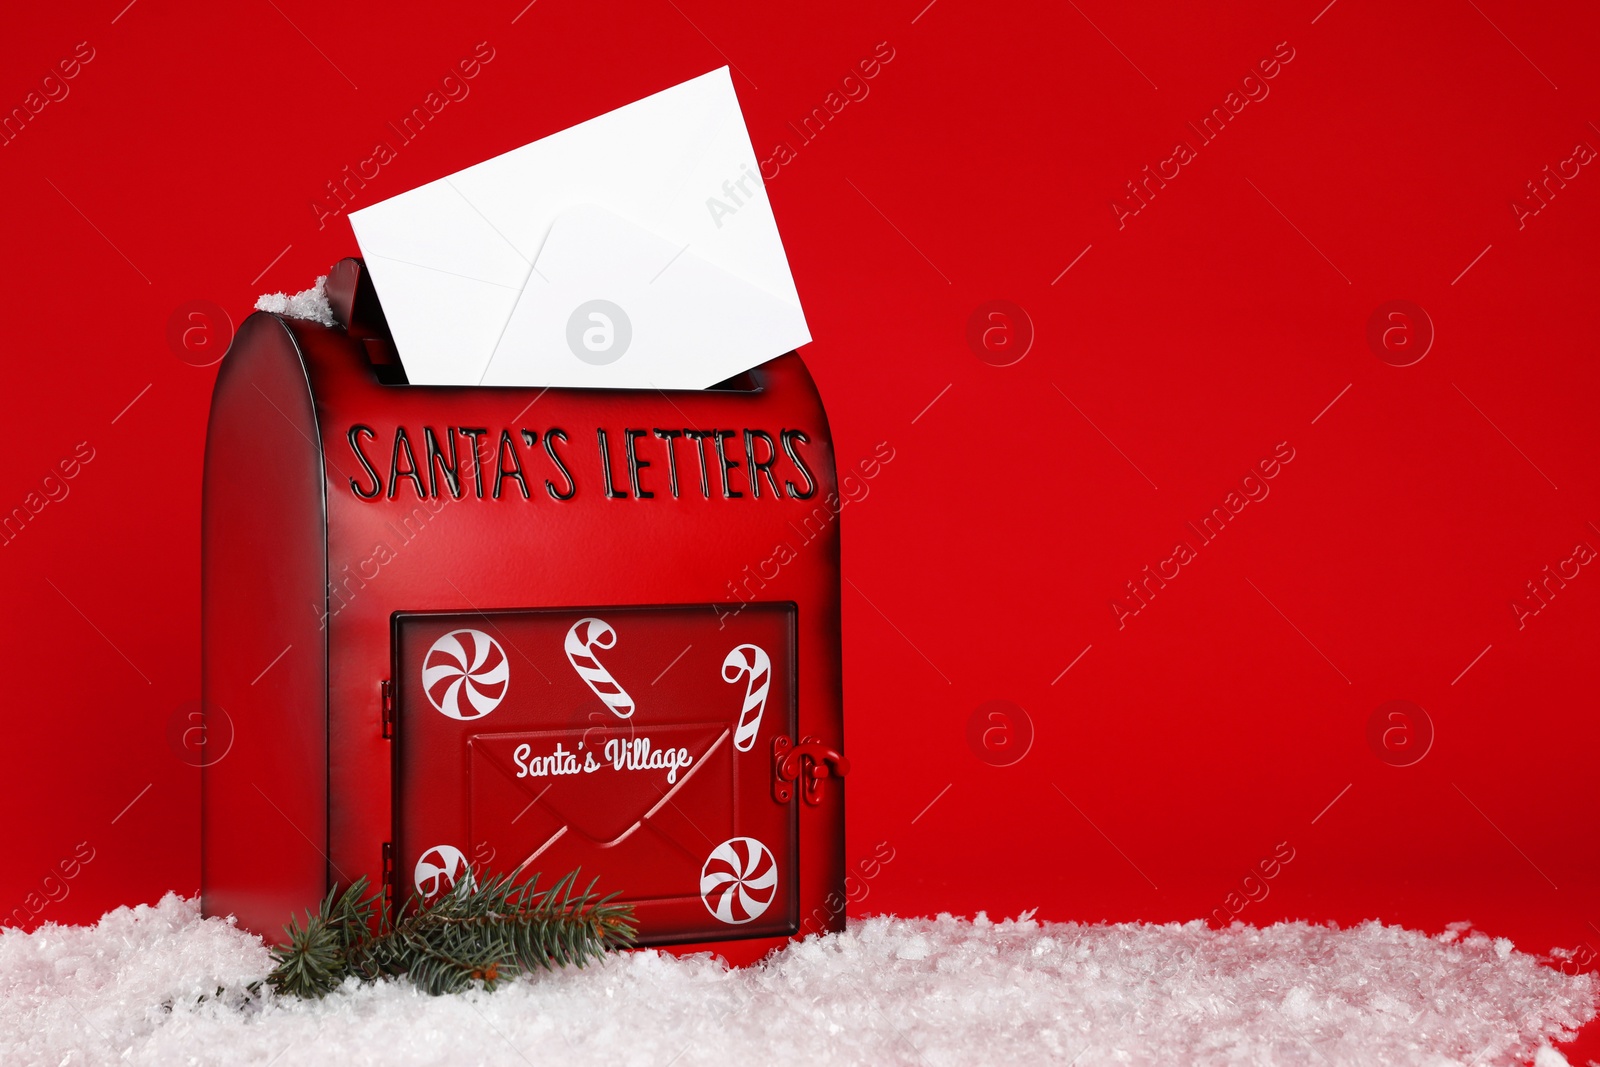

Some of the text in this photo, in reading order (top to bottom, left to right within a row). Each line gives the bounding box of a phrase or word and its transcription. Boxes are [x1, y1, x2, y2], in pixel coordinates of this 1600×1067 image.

[346, 424, 816, 500] SANTA'S LETTERS
[513, 737, 693, 785] Santa's Village
